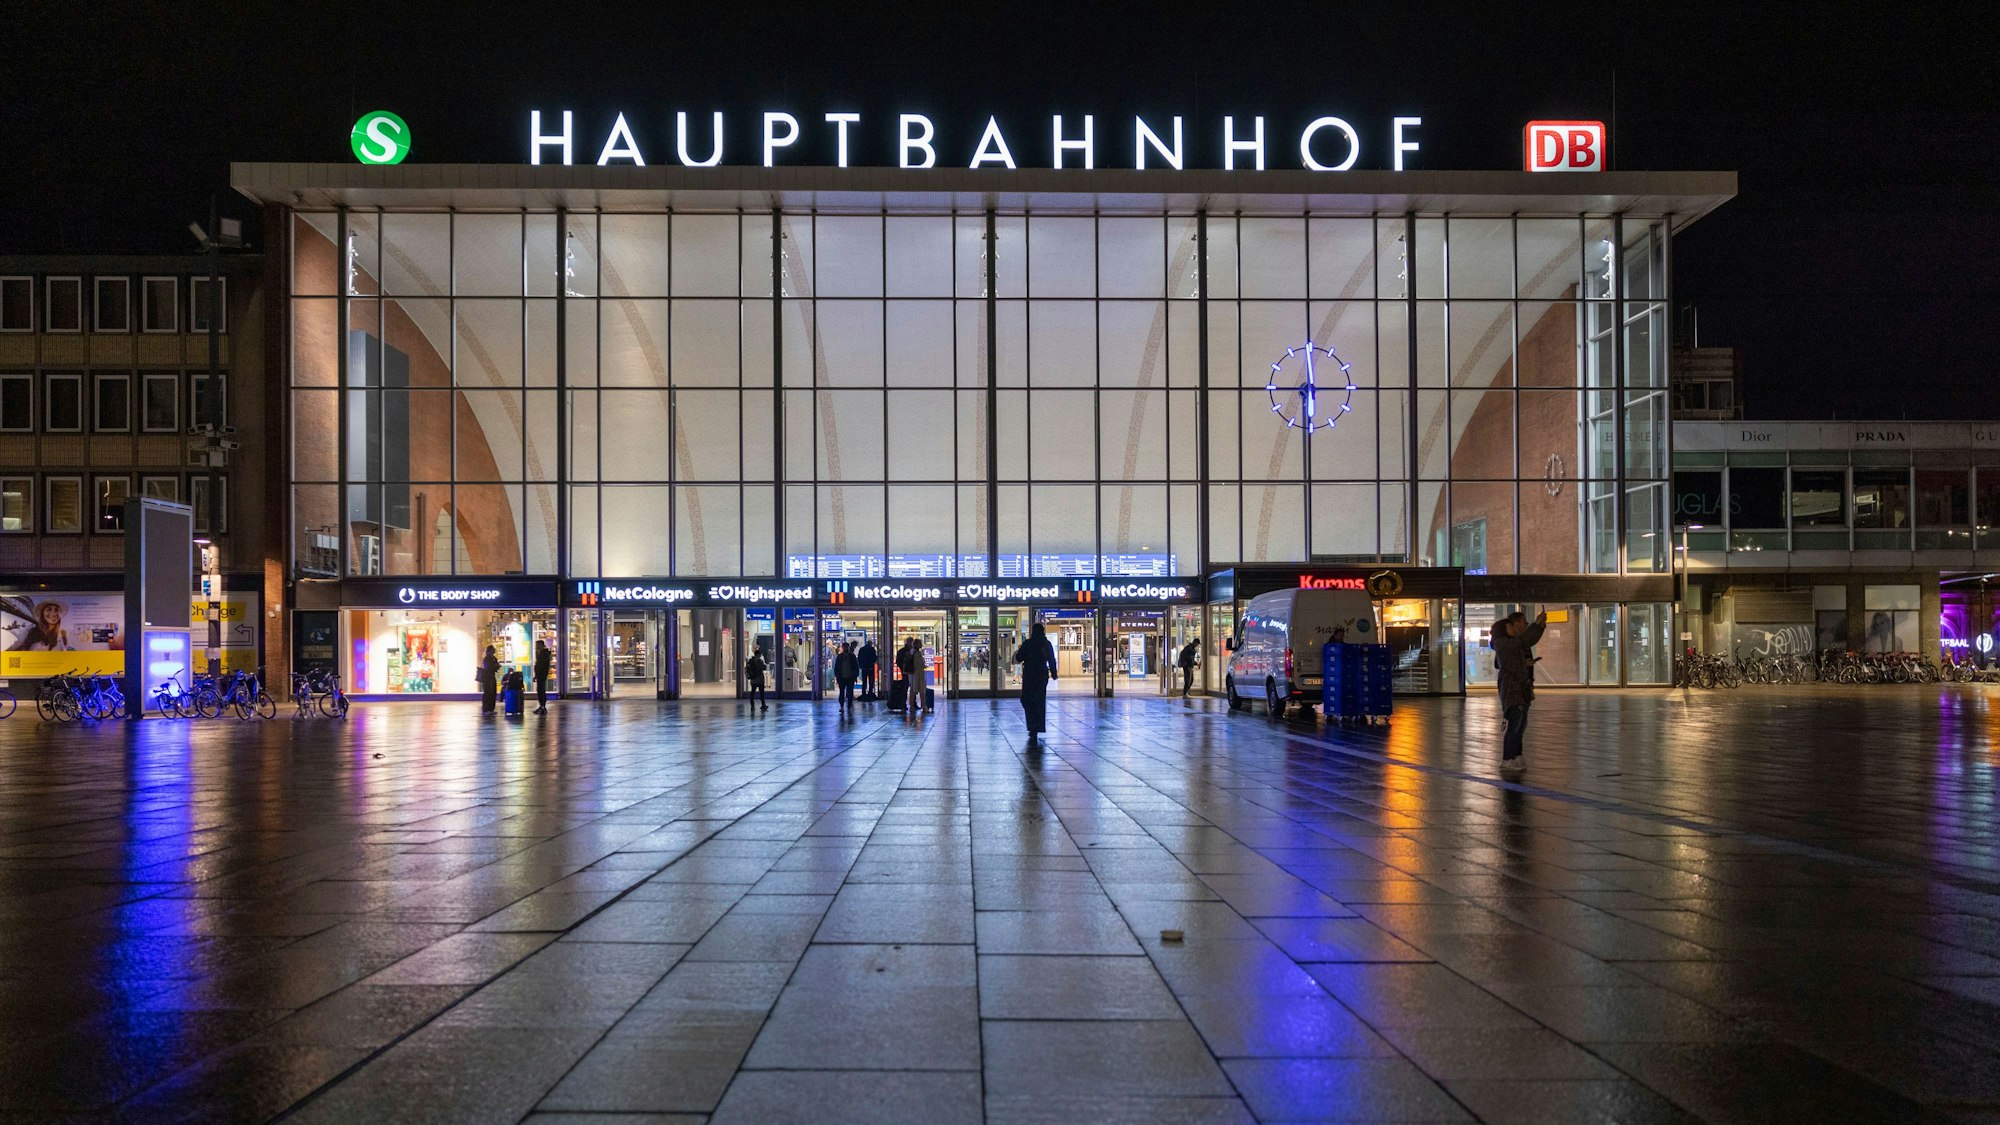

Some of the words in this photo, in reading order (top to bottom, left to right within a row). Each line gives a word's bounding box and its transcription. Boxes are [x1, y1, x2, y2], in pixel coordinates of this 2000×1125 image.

[359, 116, 401, 163] S
[530, 110, 1421, 172] HAUPTBAHNHOF
[1536, 130, 1596, 168] DB
[1741, 430, 1773, 442] Dior
[1855, 431, 1906, 442] PRADA
[1299, 575, 1366, 590] Kamps
[417, 590, 439, 601] THE
[440, 590, 469, 601] BODY
[470, 590, 500, 601] SHOP
[605, 586, 694, 602] NetCologne
[735, 586, 812, 602] Highspeed
[854, 586, 941, 602] NetCologne
[982, 584, 1059, 601] Highspeed
[1100, 584, 1187, 600] NetCologne
